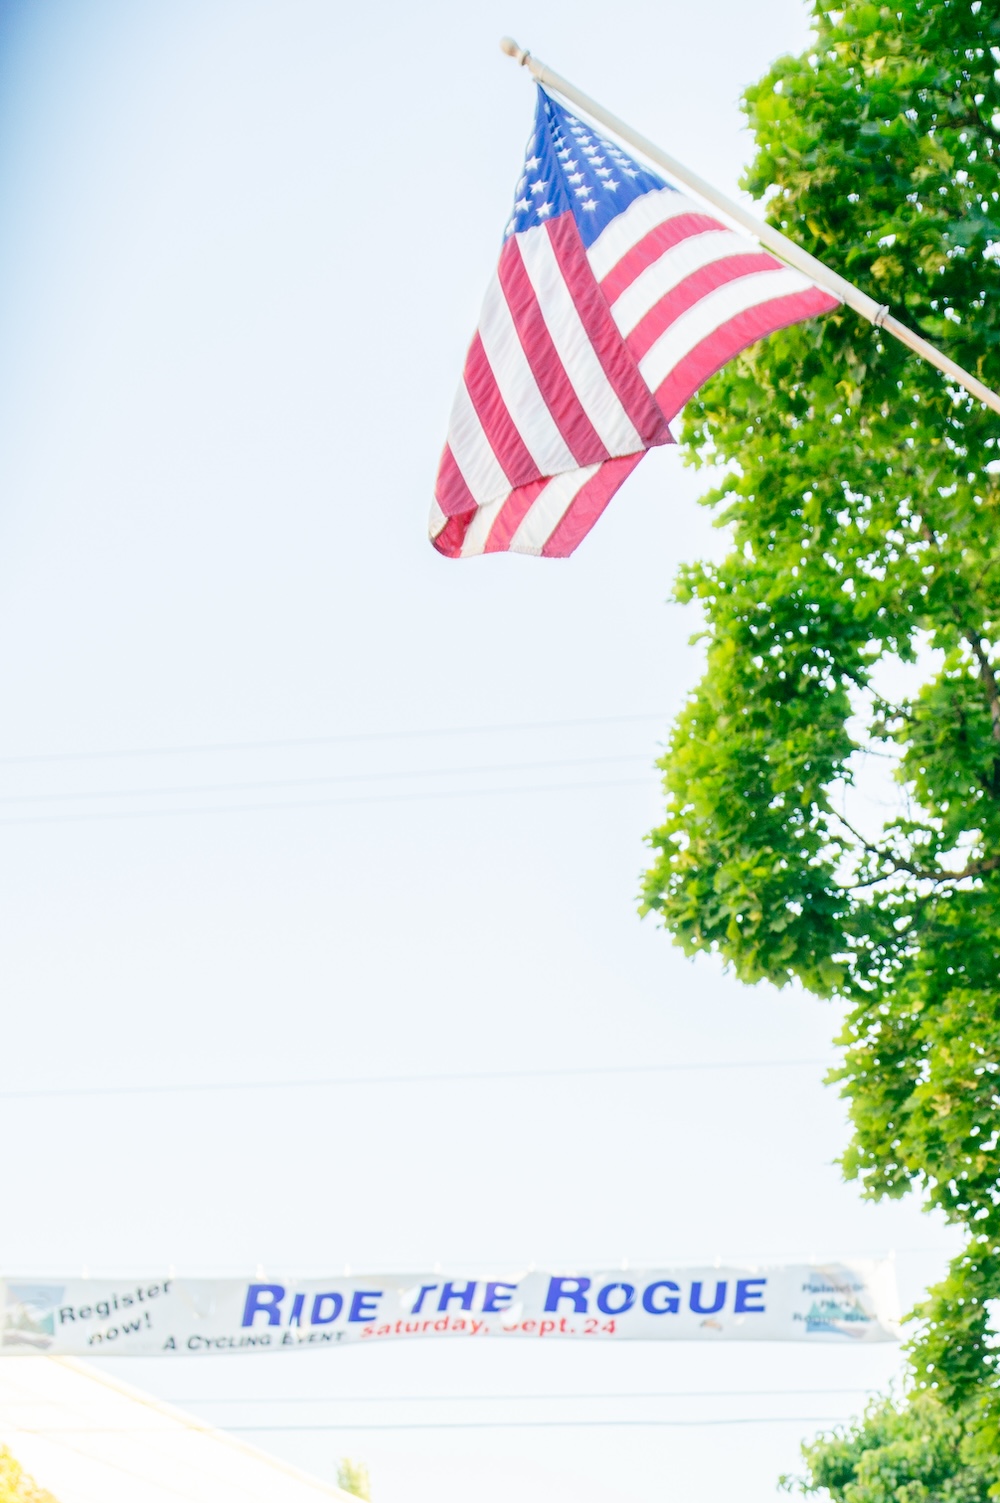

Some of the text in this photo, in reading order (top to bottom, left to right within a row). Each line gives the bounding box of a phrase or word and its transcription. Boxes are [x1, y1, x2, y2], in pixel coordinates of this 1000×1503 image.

[58, 1279, 173, 1325] Register
[241, 1276, 768, 1327] RIDE THE ROGUE
[88, 1311, 151, 1347] now!
[163, 1330, 346, 1350] A CYCLING EENT
[583, 1319, 617, 1334] 24
